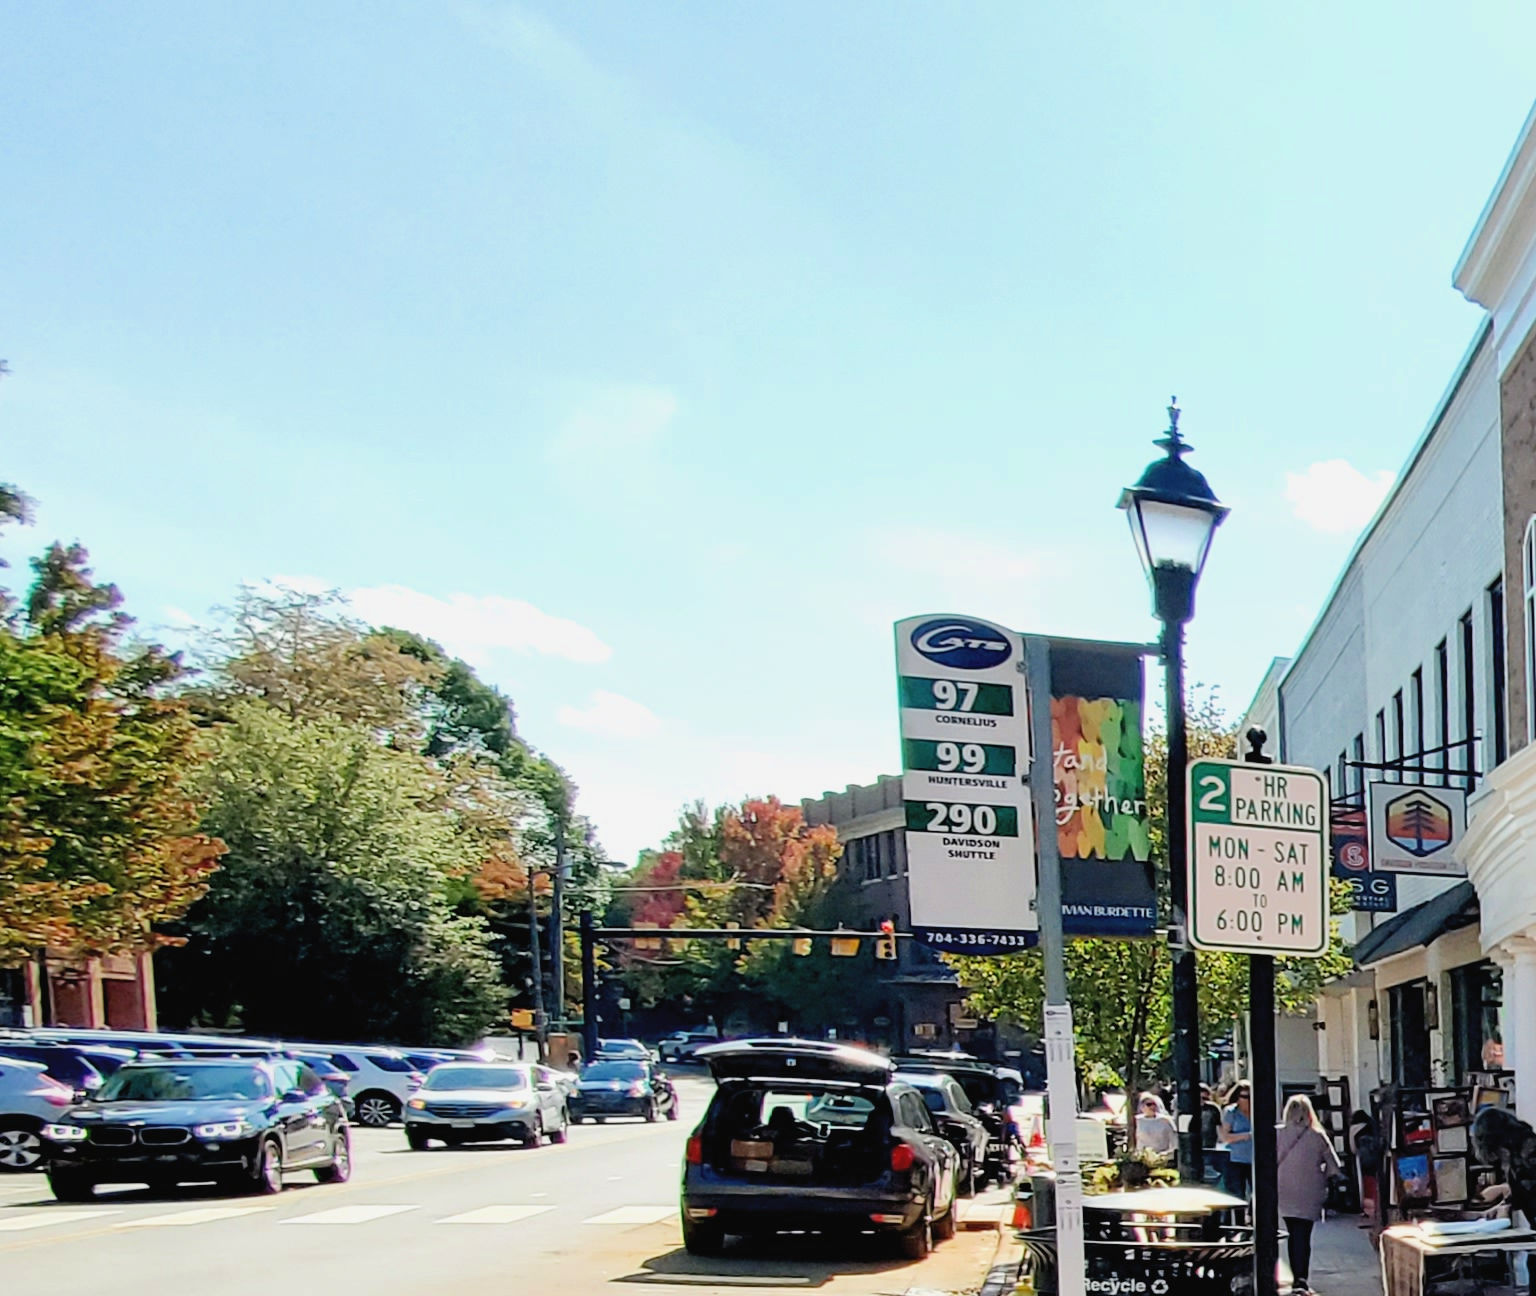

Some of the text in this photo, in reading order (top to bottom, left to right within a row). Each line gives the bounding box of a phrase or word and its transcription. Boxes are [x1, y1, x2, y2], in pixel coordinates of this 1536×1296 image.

[933, 680, 979, 711] 97
[936, 714, 997, 728] CORNELIUS
[936, 742, 986, 773] 99
[1053, 741, 1107, 773] tand
[928, 776, 1008, 789] HUNTERSVILLE
[1199, 775, 1288, 812] 2 HR
[926, 803, 997, 835] 290
[1236, 798, 1316, 826] PARKING
[942, 837, 1000, 848] DAVIDSON
[948, 849, 996, 860] SHUTTLE
[1208, 835, 1249, 860] MON
[1274, 841, 1309, 865] SAT
[1215, 865, 1304, 893] 8:00 AM
[1253, 894, 1268, 908] TO
[1216, 909, 1303, 936] 6:00 PM
[926, 932, 1025, 946] 704-336-7433
[1084, 1278, 1147, 1295] Recycle
